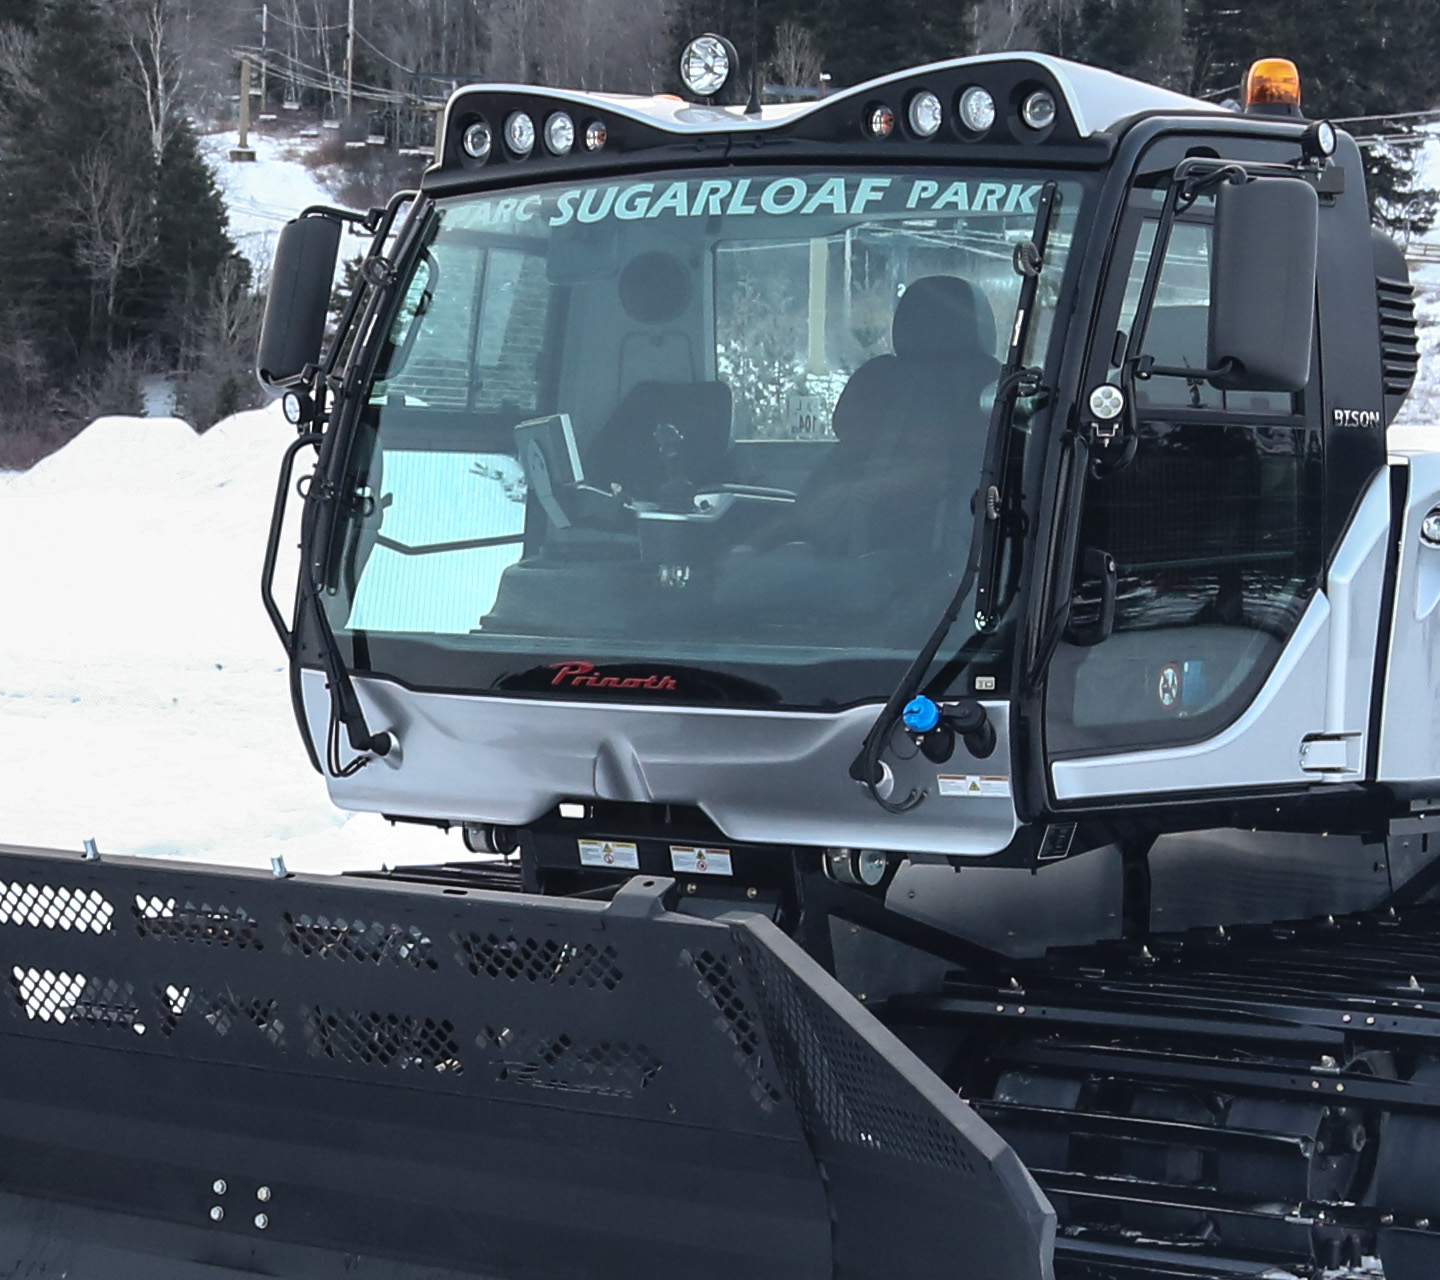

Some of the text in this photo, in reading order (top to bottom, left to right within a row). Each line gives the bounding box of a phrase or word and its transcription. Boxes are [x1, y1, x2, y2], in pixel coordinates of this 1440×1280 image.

[549, 178, 892, 226] SUGARLOAF
[906, 180, 1043, 213] PARK
[1334, 409, 1380, 428] BISON
[549, 661, 677, 690] Prinoth
